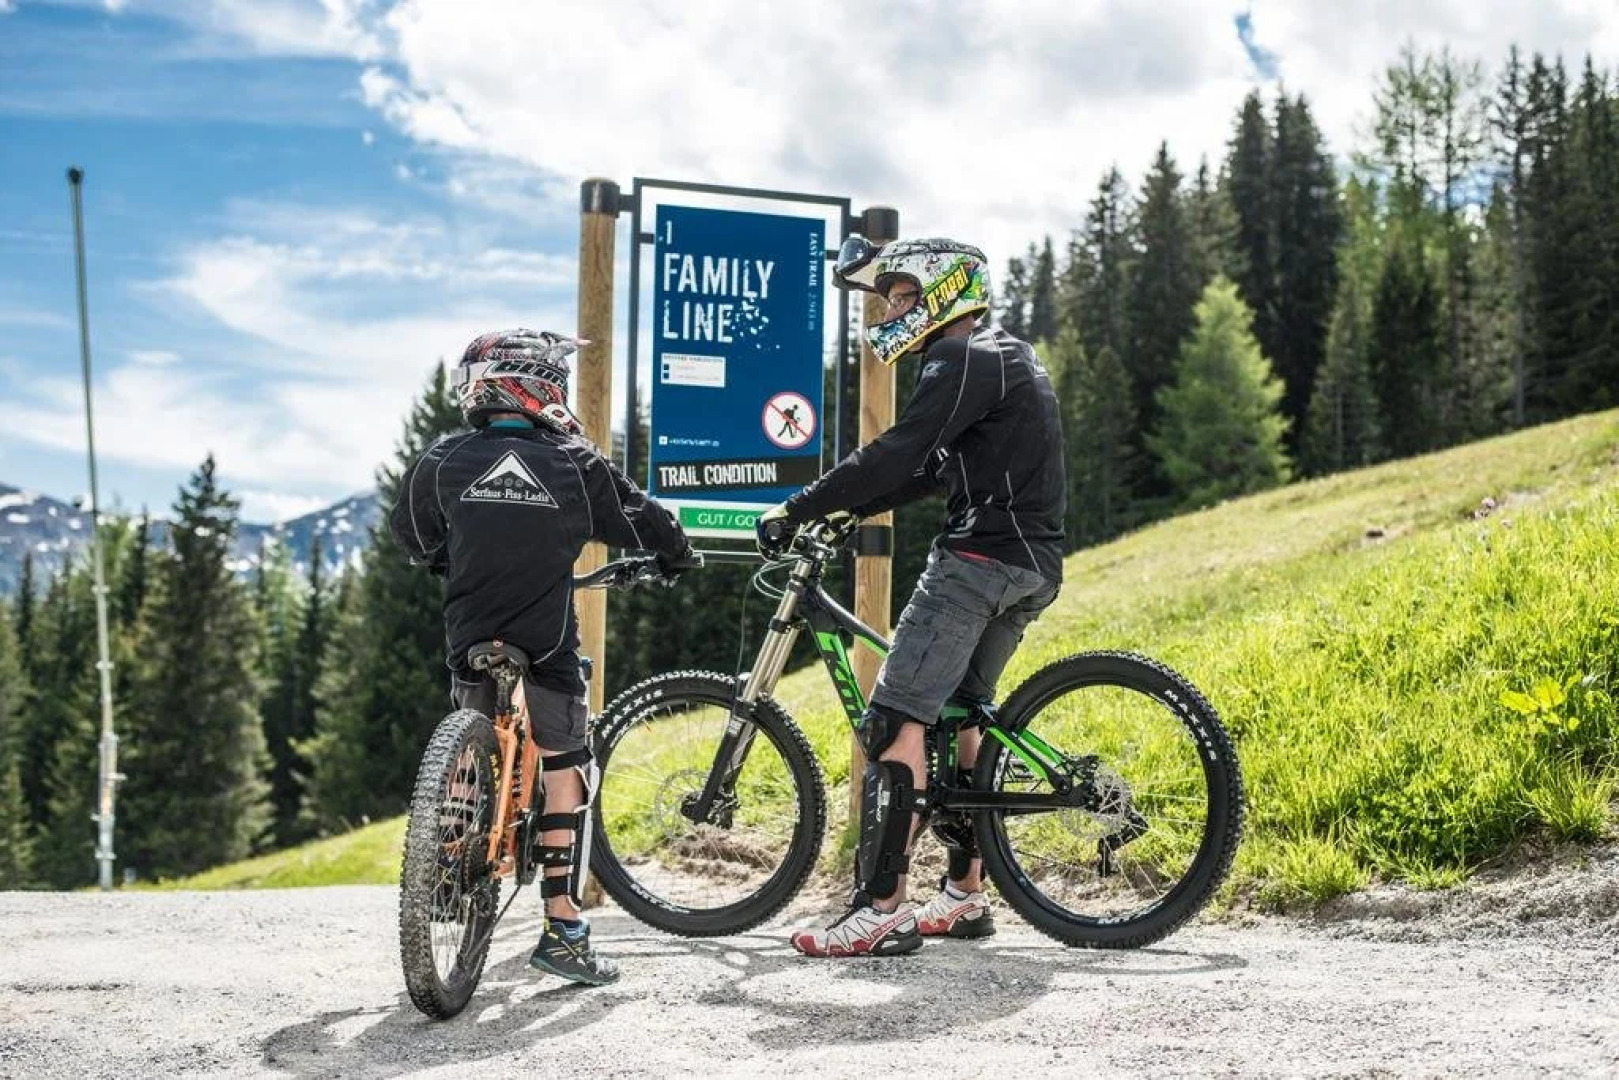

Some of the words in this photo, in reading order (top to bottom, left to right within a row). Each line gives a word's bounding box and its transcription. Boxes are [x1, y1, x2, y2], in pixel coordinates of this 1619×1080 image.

[663, 252, 775, 300] FAMILY
[663, 300, 734, 344] LINE
[658, 465, 702, 488] TRAIL
[704, 461, 778, 485] CONDITION
[698, 512, 725, 526] GUT
